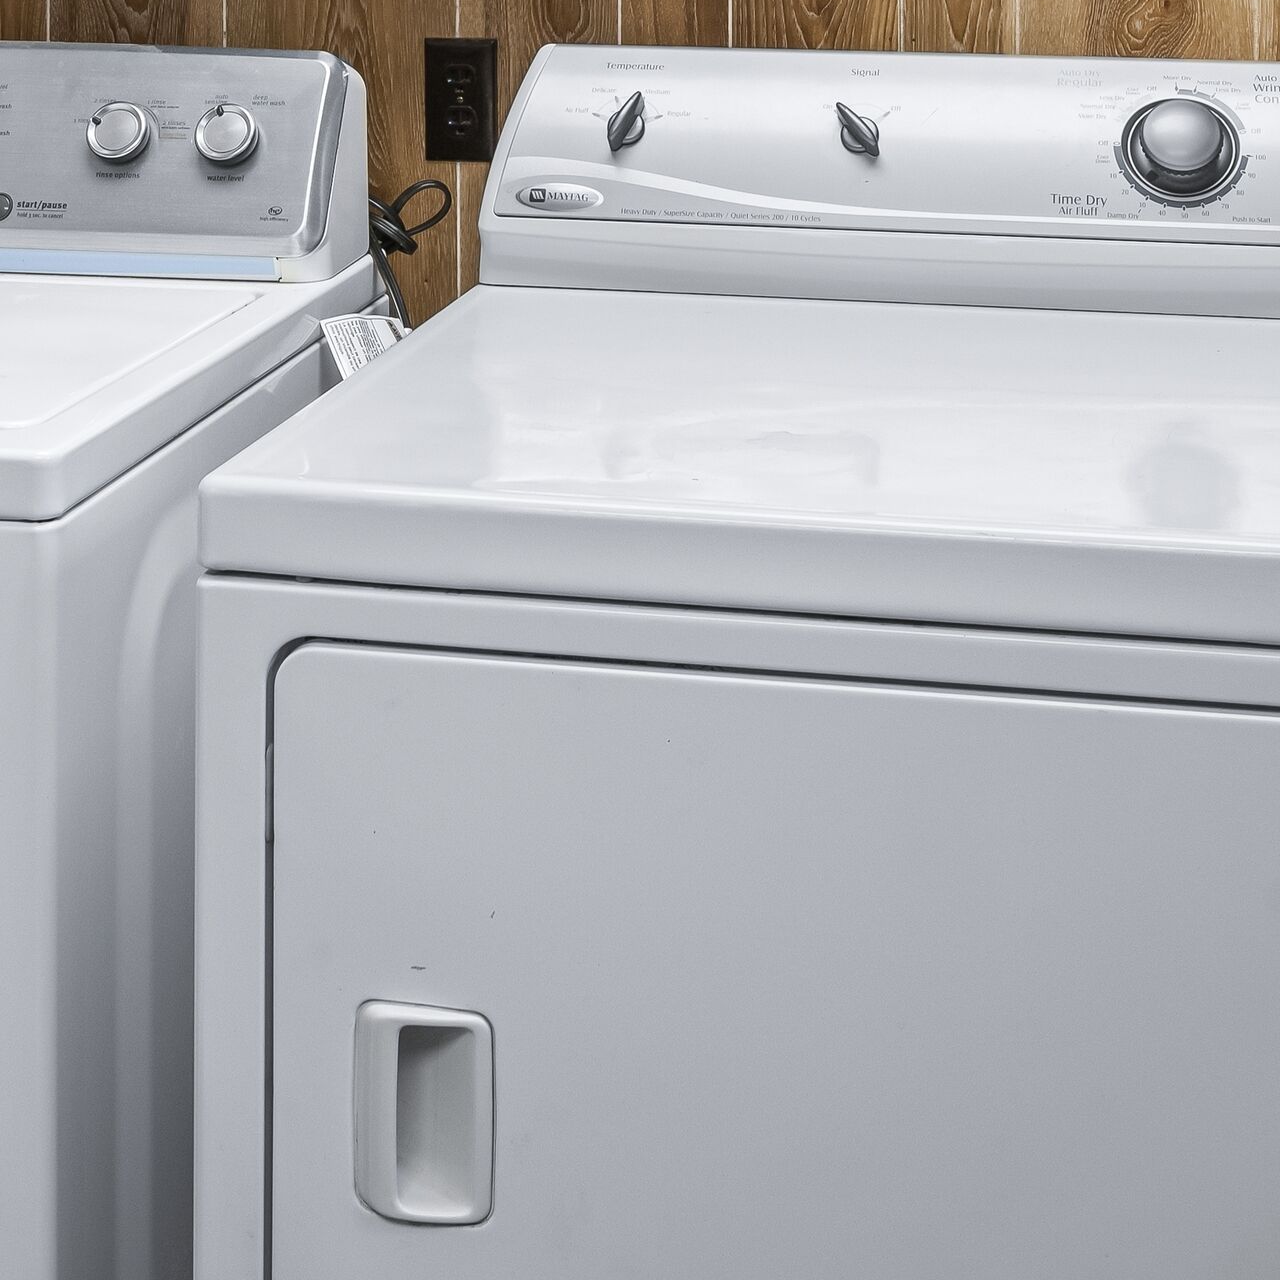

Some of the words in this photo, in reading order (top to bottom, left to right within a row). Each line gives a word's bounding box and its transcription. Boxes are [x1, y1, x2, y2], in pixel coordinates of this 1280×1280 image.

[607, 62, 665, 70] Temperature
[851, 68, 880, 77] Signal
[1057, 78, 1103, 88] Regular
[548, 192, 589, 202] MAYTAG
[1050, 193, 1081, 205] Time
[1086, 194, 1107, 207] Dry
[17, 200, 67, 210] start/pause
[620, 207, 640, 216] Heavy
[642, 208, 657, 217] Duty
[664, 209, 695, 218] SuperSize
[697, 210, 724, 219] Capacity
[730, 212, 749, 220] Quiet
[800, 215, 821, 223] Cycles
[1059, 207, 1072, 215] Air
[1076, 207, 1098, 216] Fluff
